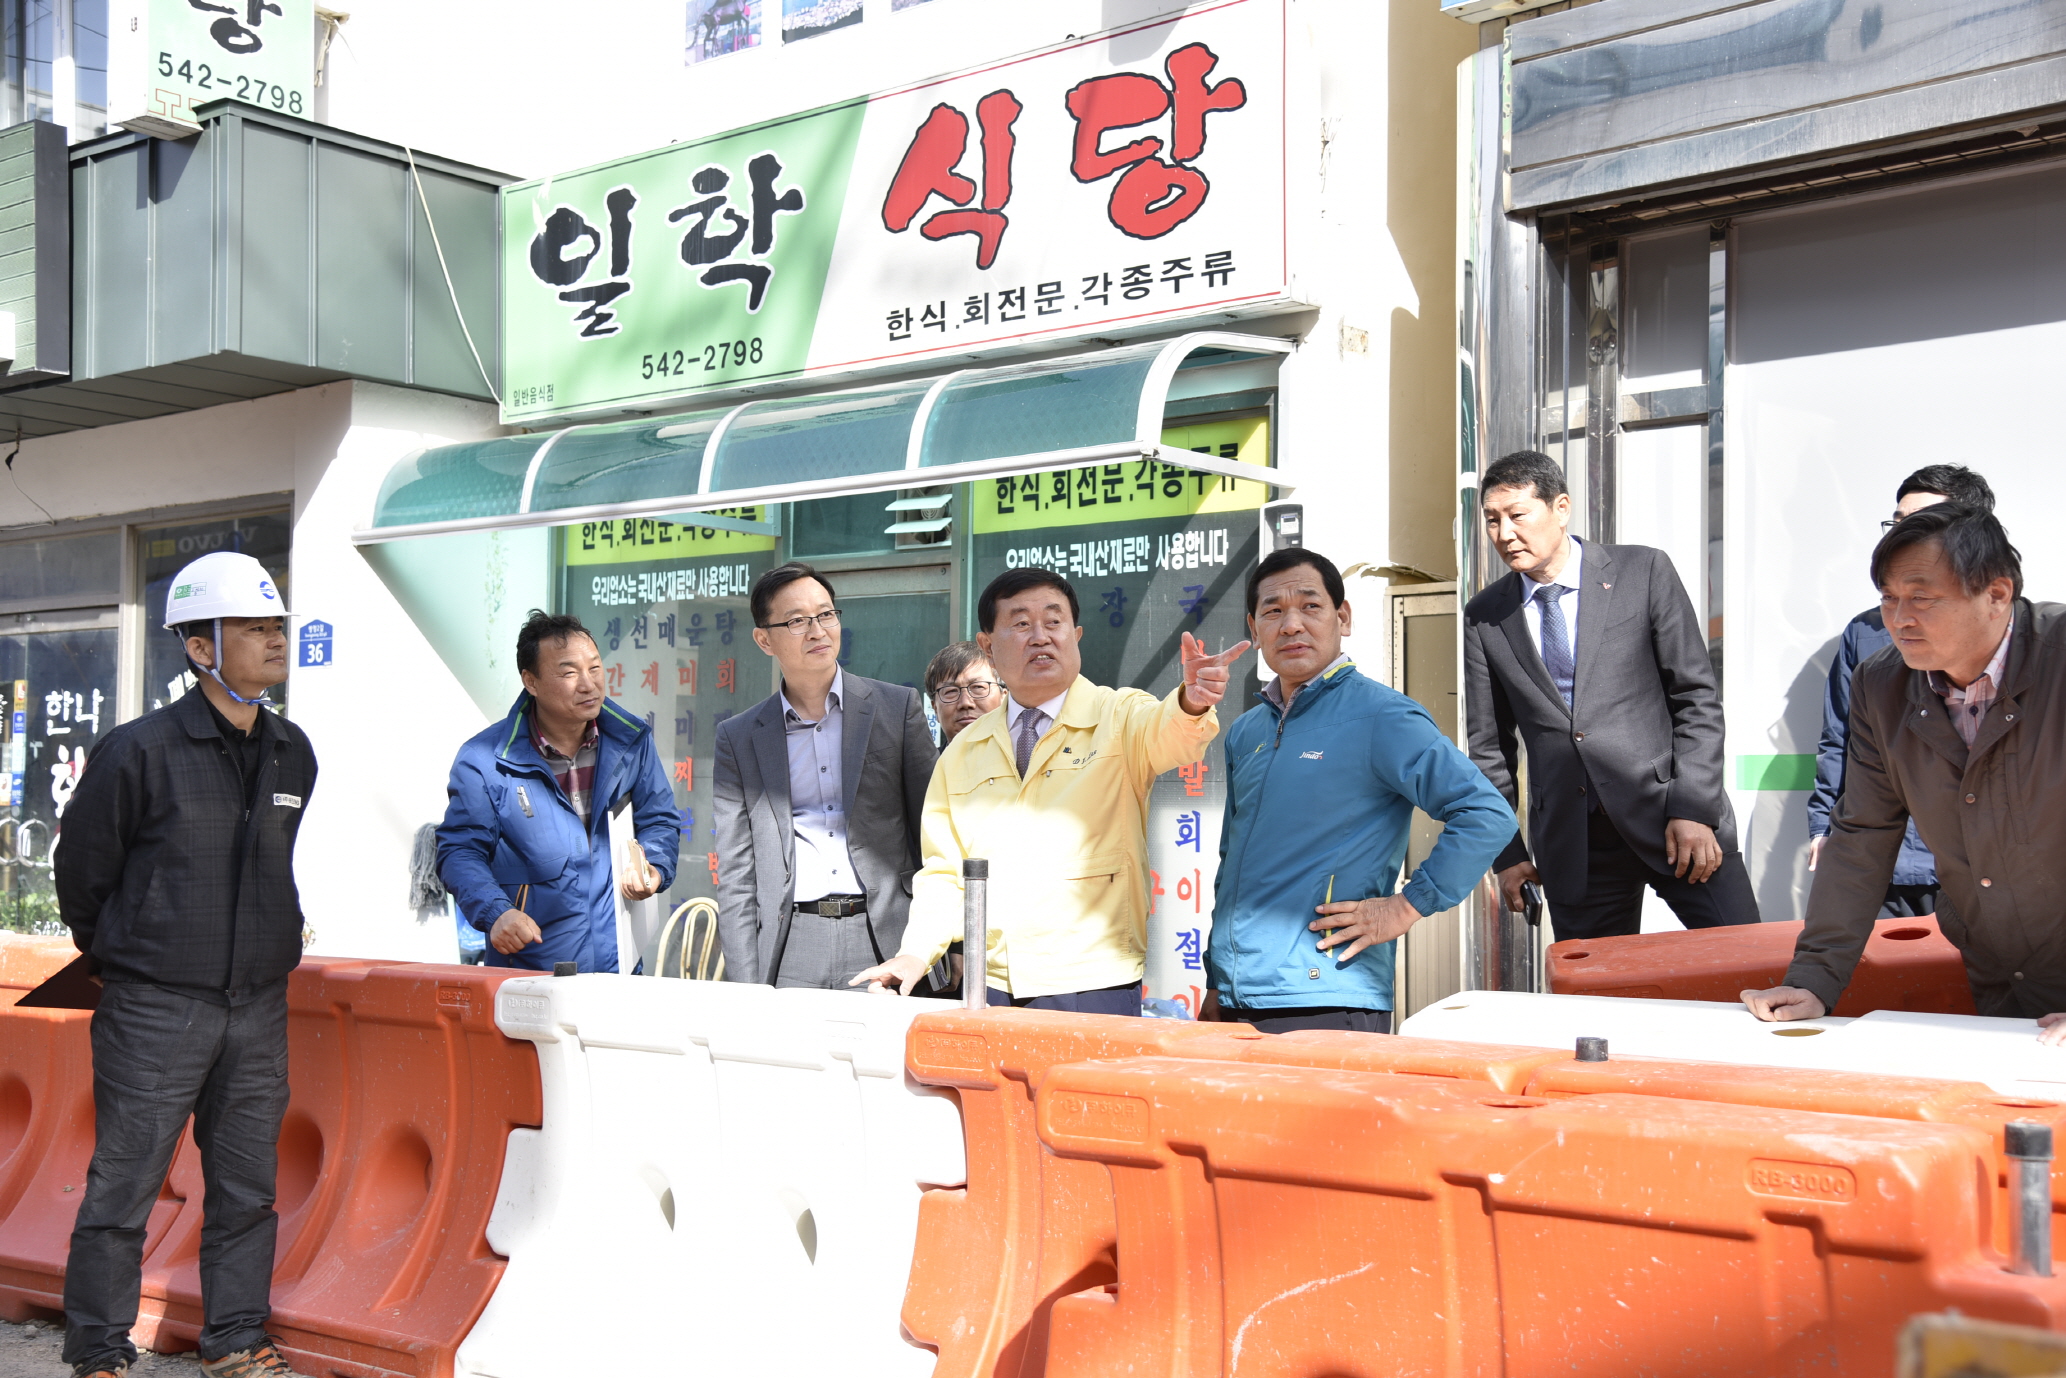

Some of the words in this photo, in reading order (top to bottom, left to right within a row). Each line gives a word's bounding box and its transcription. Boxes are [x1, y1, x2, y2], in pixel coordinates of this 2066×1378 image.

[158, 51, 303, 114] 542-2798
[529, 152, 804, 338] 일학
[882, 42, 1247, 270] 식당
[641, 337, 763, 380] 542-2798
[513, 384, 554, 407] 일반음식점
[1155, 528, 1229, 571] 사용합니다
[592, 573, 637, 607] 우리업소는
[697, 563, 750, 598] 사용합니다
[604, 609, 738, 652] 생선매운탕
[307, 643, 324, 663] 36
[1751, 1168, 1849, 1195] RB-3000
